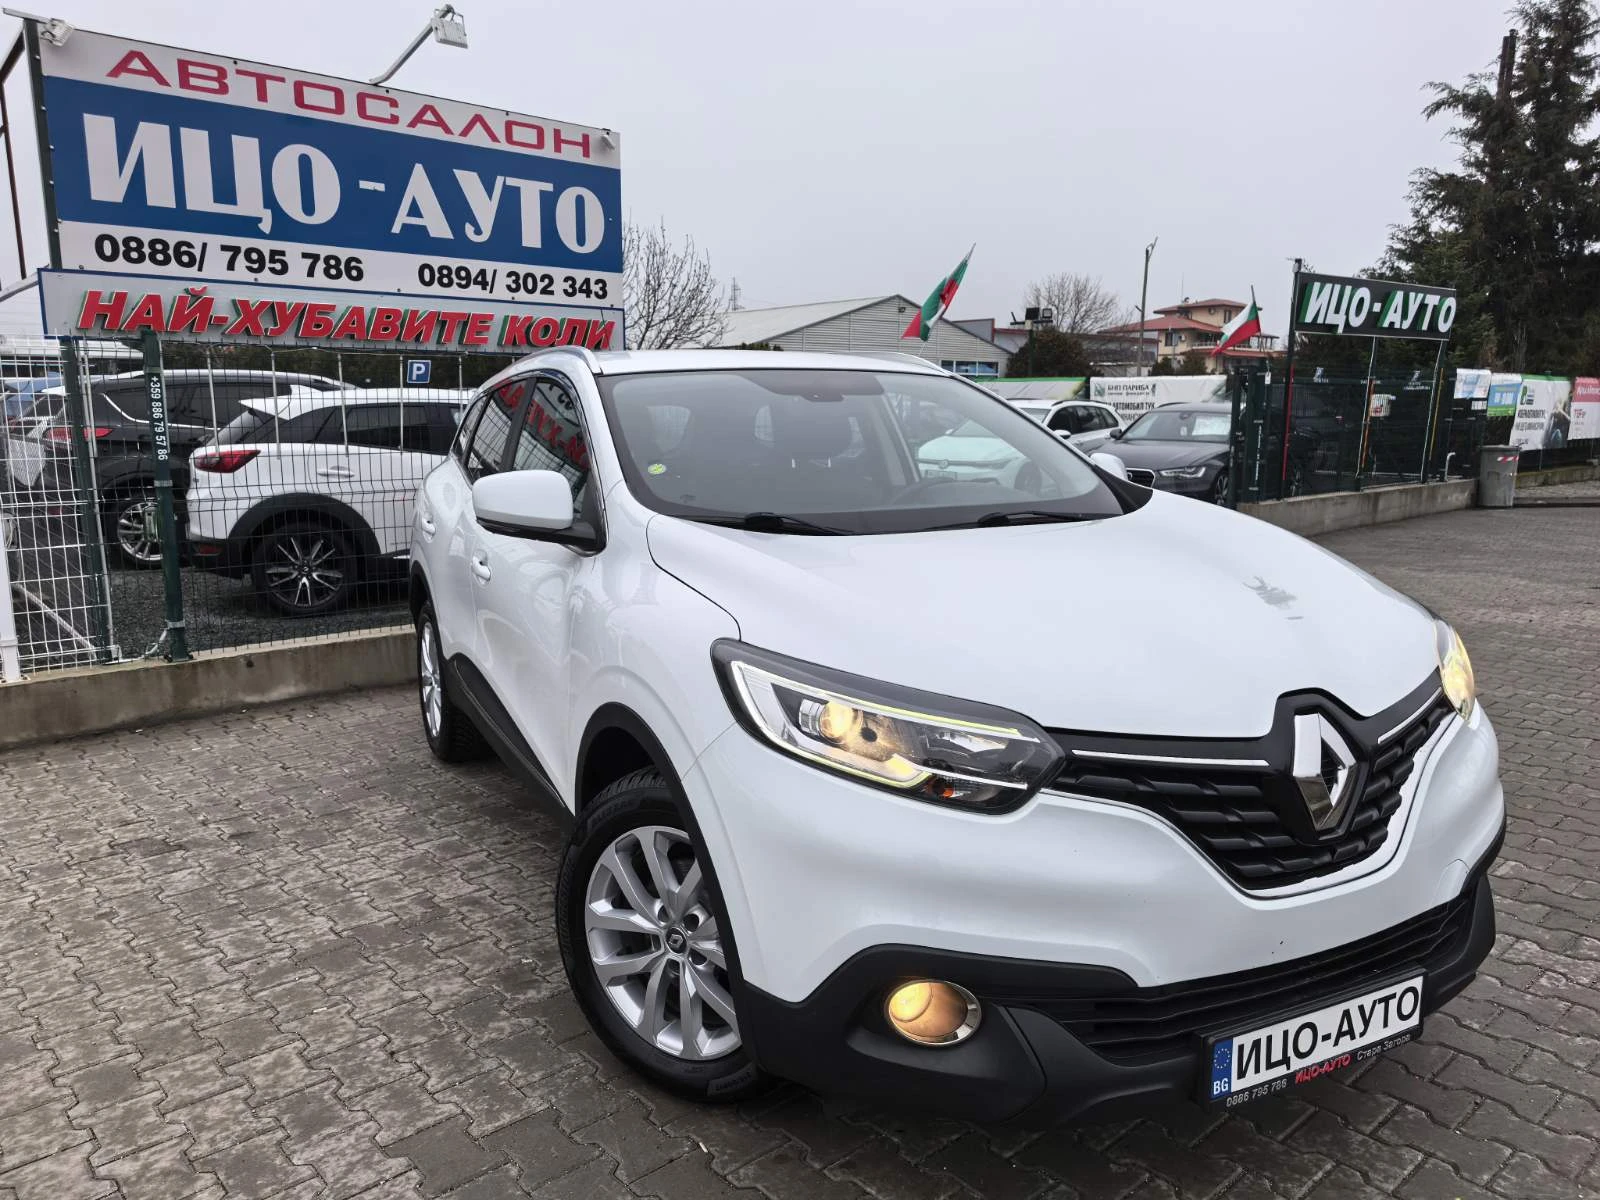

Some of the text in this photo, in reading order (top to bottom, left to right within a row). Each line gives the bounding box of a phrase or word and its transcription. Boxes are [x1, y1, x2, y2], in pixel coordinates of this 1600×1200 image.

[106, 50, 592, 159] АВТОСАЛОН
[94, 233, 365, 282] 0886/ 795 786
[418, 263, 608, 300] 0894/ 302 343
[77, 285, 615, 350] НАЙ-ХУБАВИТЕ КОЛИ
[1304, 281, 1457, 334] ИЦО-АУТО
[412, 363, 427, 380] P
[150, 376, 169, 461] +359 886 79 57 86
[1236, 986, 1420, 1081] ИЦО-АУТО
[1213, 1077, 1229, 1096] BG
[1226, 1091, 1249, 1108] 0886
[1252, 1085, 1269, 1099] 795
[1295, 1054, 1352, 1084] ИЦО-АУТО
